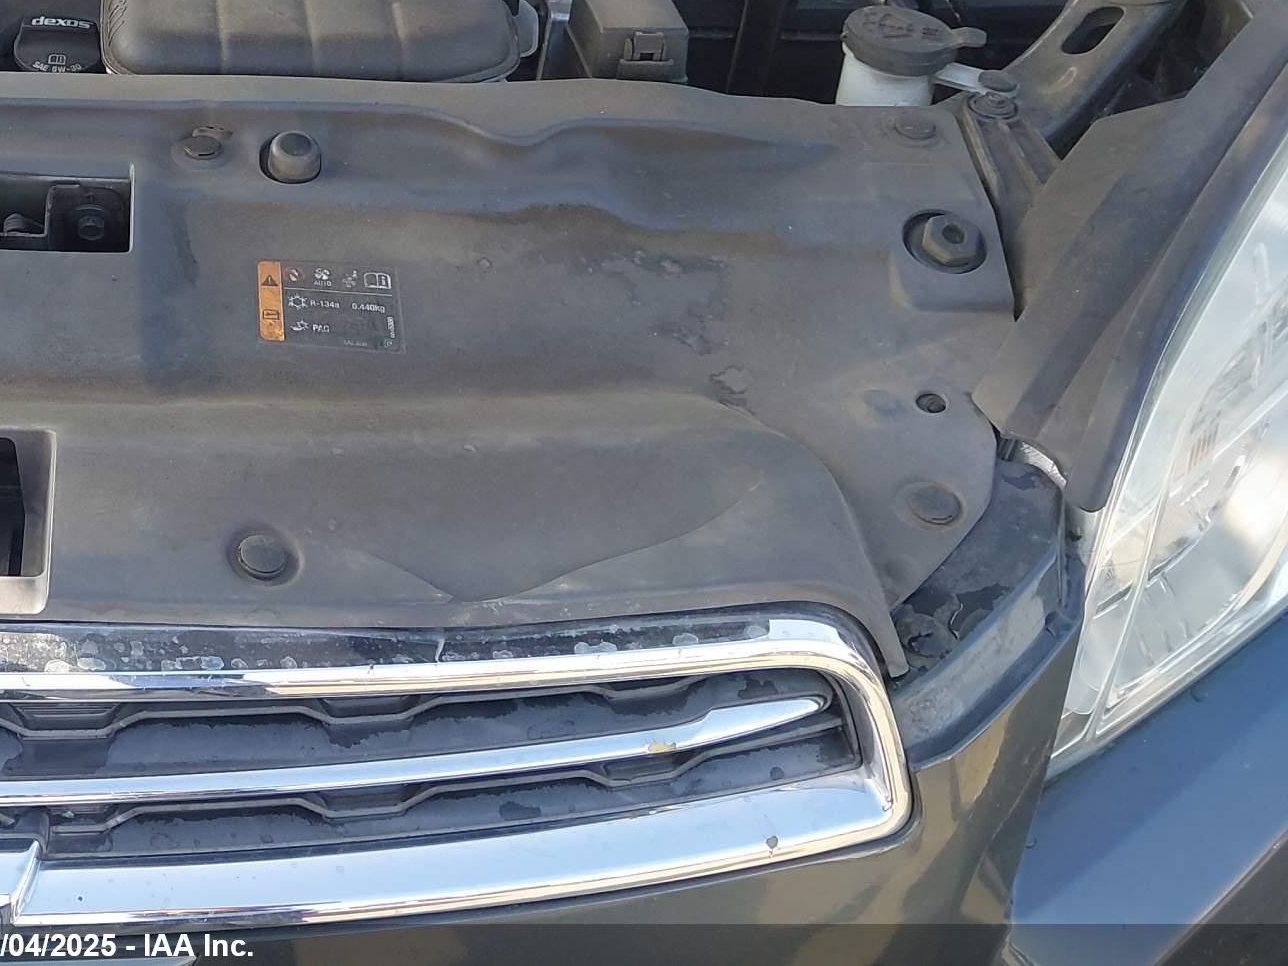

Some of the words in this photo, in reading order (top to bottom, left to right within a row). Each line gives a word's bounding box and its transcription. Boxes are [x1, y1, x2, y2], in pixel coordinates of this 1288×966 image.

[31, 16, 91, 29] dexos
[32, 60, 49, 72] SAE
[51, 63, 82, 73] 5W-30
[310, 299, 340, 309] R-134a
